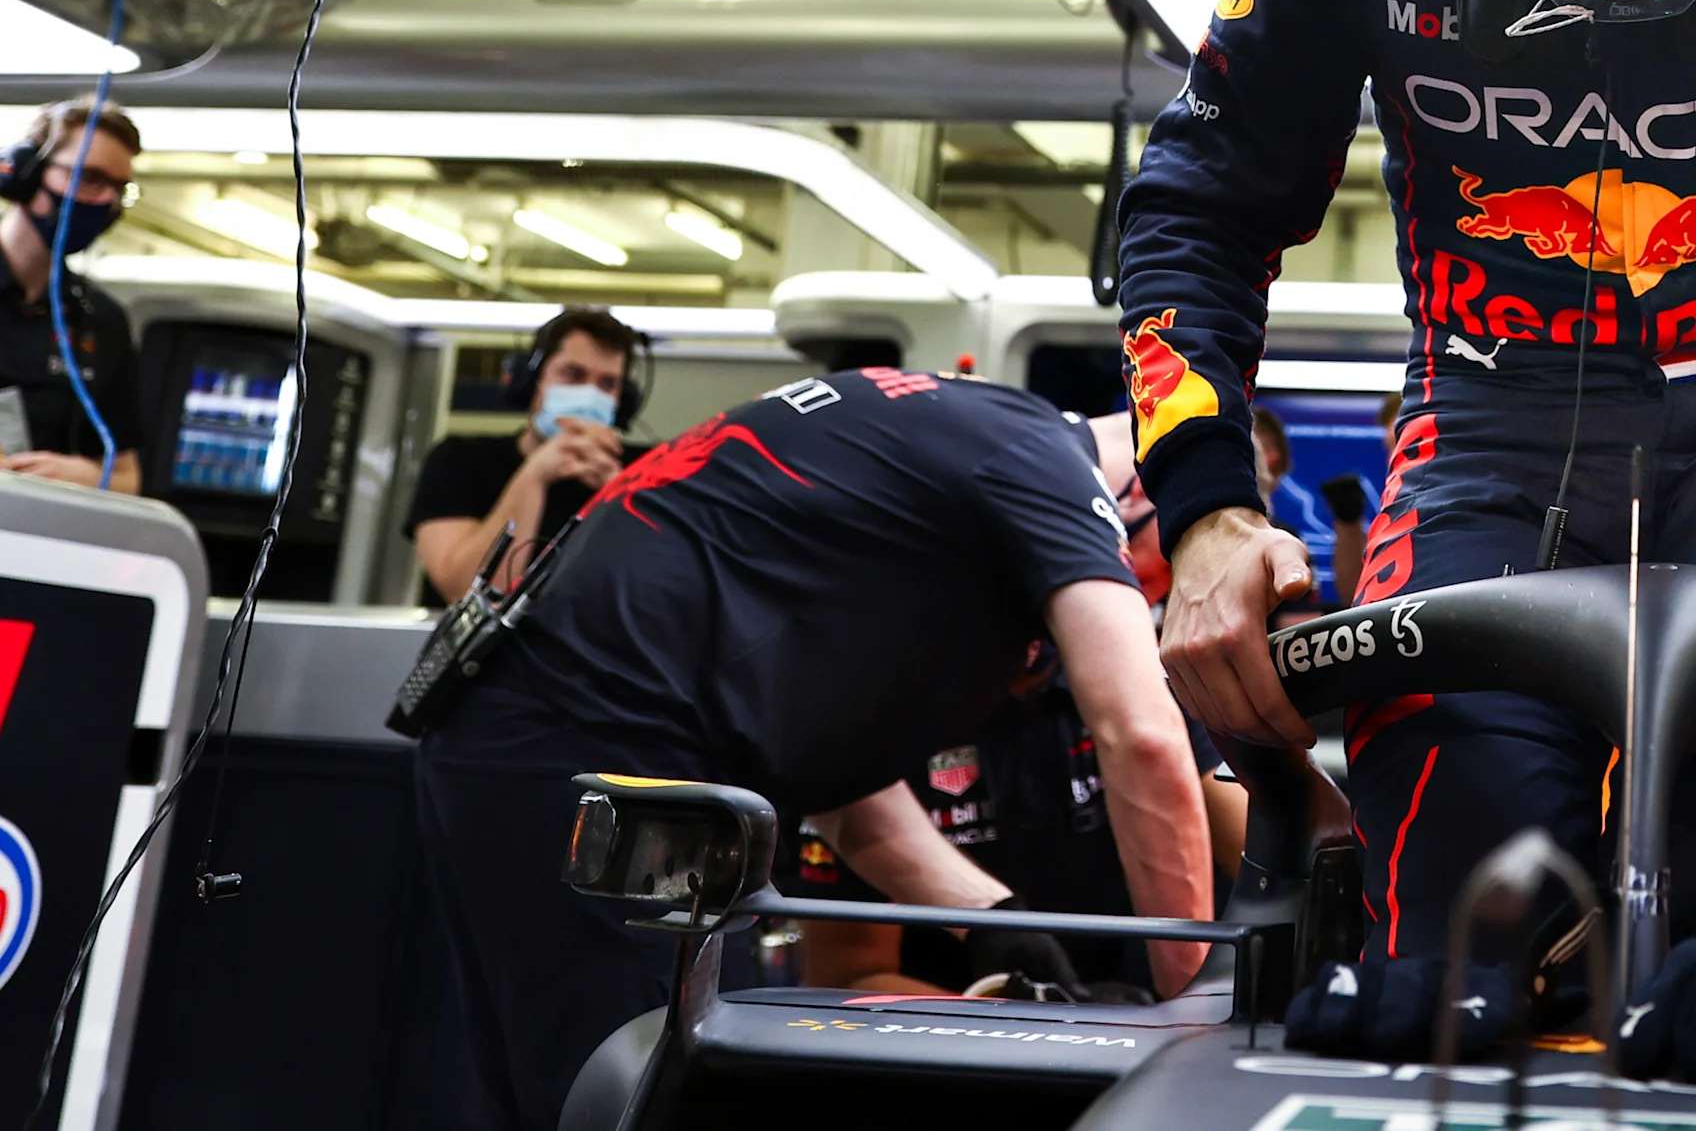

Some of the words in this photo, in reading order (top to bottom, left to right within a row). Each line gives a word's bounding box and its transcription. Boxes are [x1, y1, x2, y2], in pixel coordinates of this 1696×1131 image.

[1430, 249, 1618, 346] Red
[1273, 619, 1377, 678] Tezos
[875, 1023, 1136, 1049] Walmart
